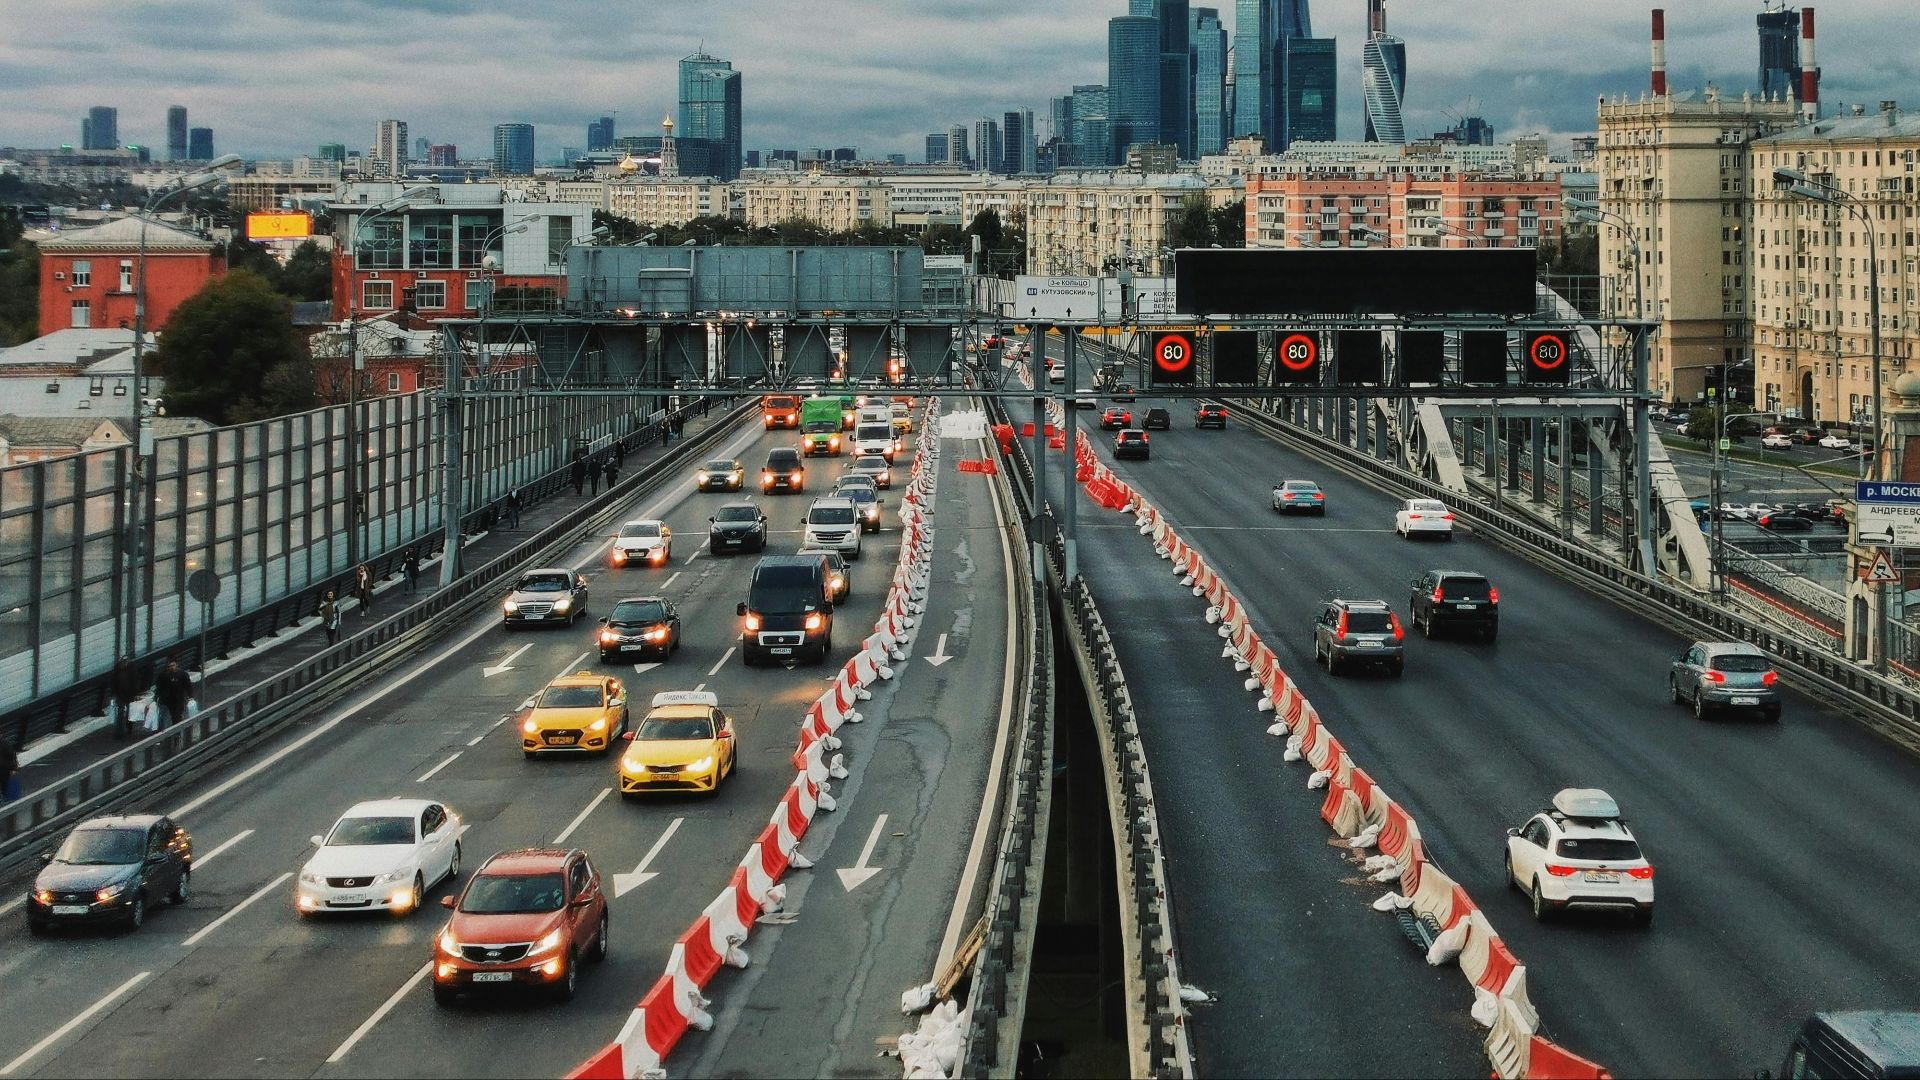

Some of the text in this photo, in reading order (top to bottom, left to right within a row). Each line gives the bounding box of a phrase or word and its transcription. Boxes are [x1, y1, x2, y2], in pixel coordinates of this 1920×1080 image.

[1164, 346, 1182, 360] 80
[1289, 344, 1307, 358] 80
[1540, 345, 1558, 358] 80
[1866, 488, 1878, 498] р.
